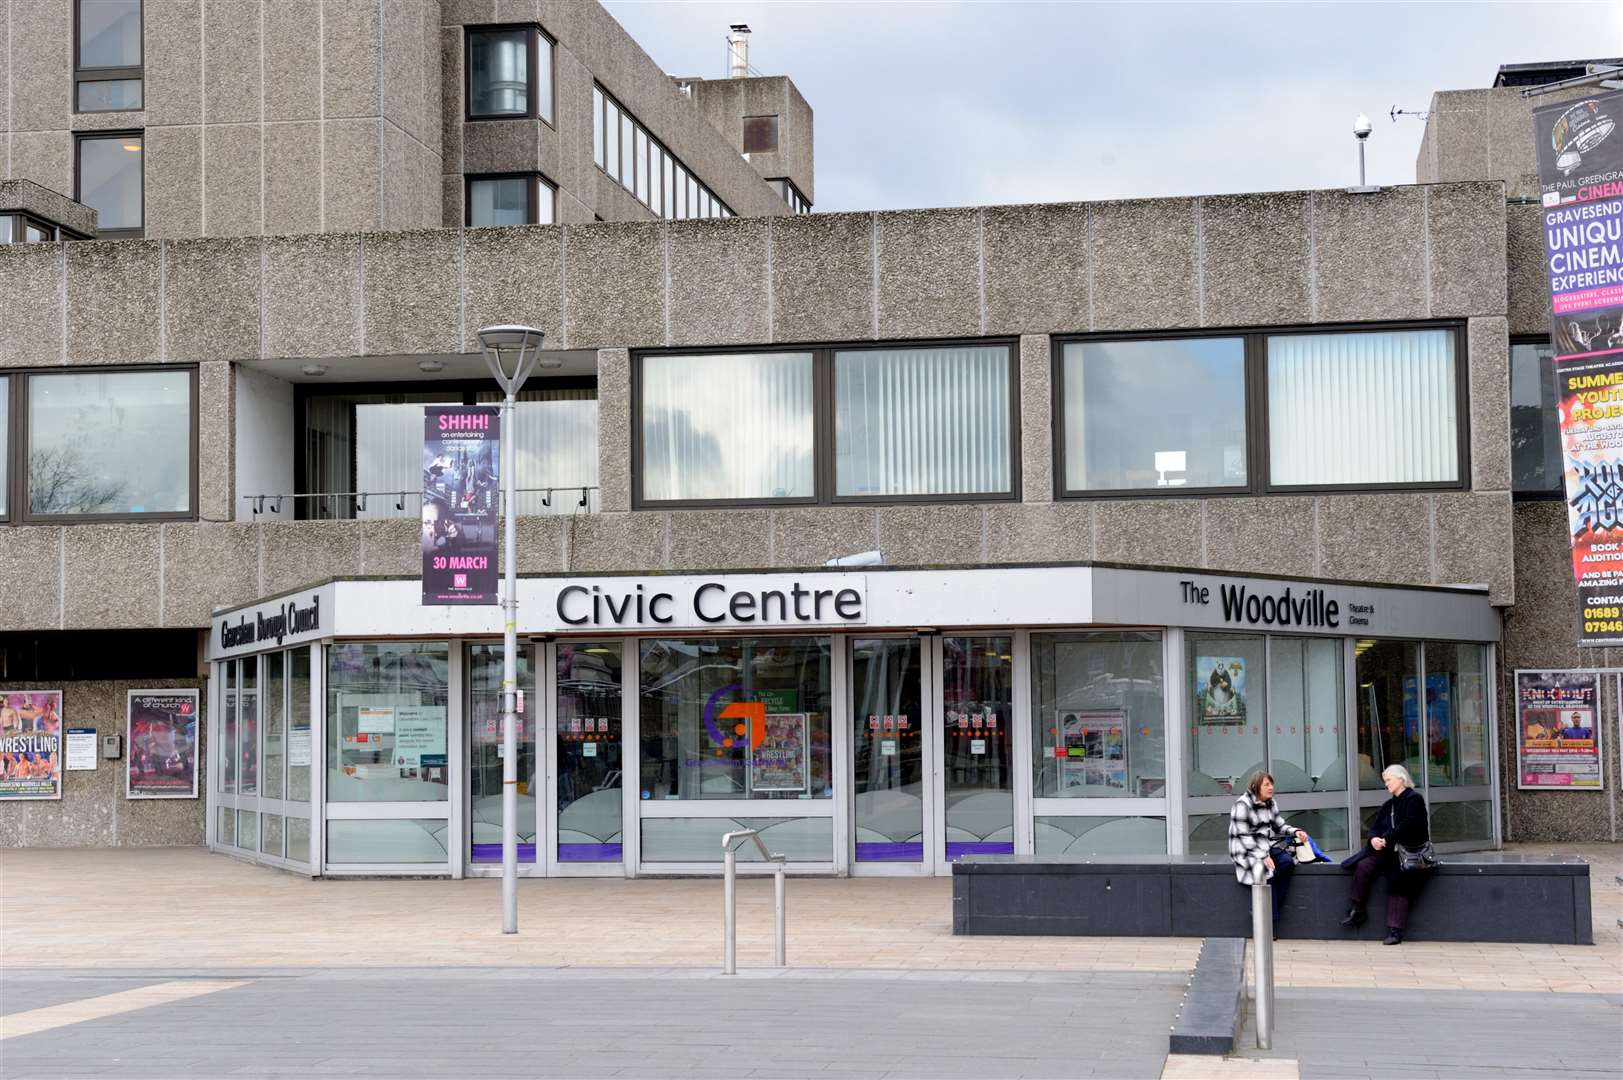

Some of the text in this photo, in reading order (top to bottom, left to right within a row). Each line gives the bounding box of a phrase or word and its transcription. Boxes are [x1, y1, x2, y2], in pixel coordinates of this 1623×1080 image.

[1542, 182, 1555, 193] THE
[1556, 179, 1577, 190] PAUL
[1550, 244, 1623, 274] CINEM
[1567, 371, 1623, 390] SUMME
[1573, 404, 1623, 422] PROJE
[438, 413, 489, 430] SHHH!
[450, 431, 484, 439] entertaining
[1590, 543, 1619, 553] BOOK
[433, 556, 488, 569] 30 MARCH
[1582, 552, 1623, 563] AUDITIO
[1582, 571, 1601, 579] AND
[1602, 570, 1612, 578] BE
[1578, 579, 1618, 587] AMAZING
[556, 581, 862, 626] Civic Centre
[1180, 580, 1340, 628] The Woodville
[1349, 603, 1375, 614] Theatre &
[1583, 606, 1620, 619] 01689
[221, 595, 319, 649] Gravesham Borough Council
[1349, 615, 1368, 626] Cinema
